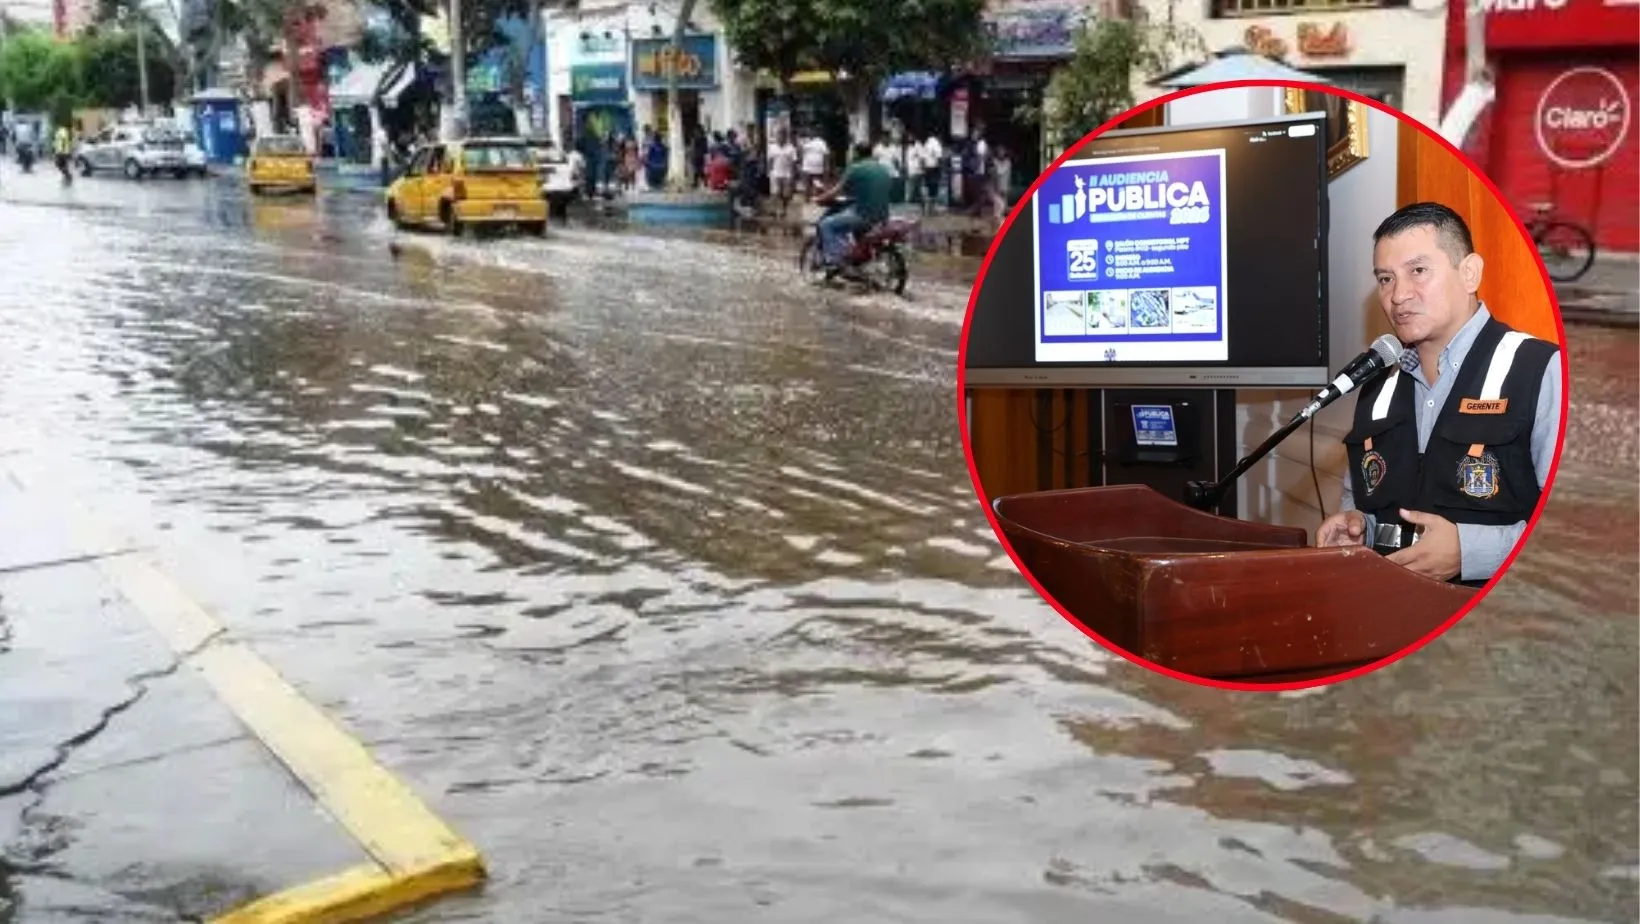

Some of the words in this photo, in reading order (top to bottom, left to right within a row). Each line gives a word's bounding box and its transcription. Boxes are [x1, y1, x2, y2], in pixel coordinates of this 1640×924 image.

[1546, 107, 1608, 129] Claro
[1089, 175, 1098, 187] II
[1099, 170, 1169, 187] AUDIENCIA
[1070, 251, 1096, 272] 25
[1466, 402, 1501, 410] GERENTE
